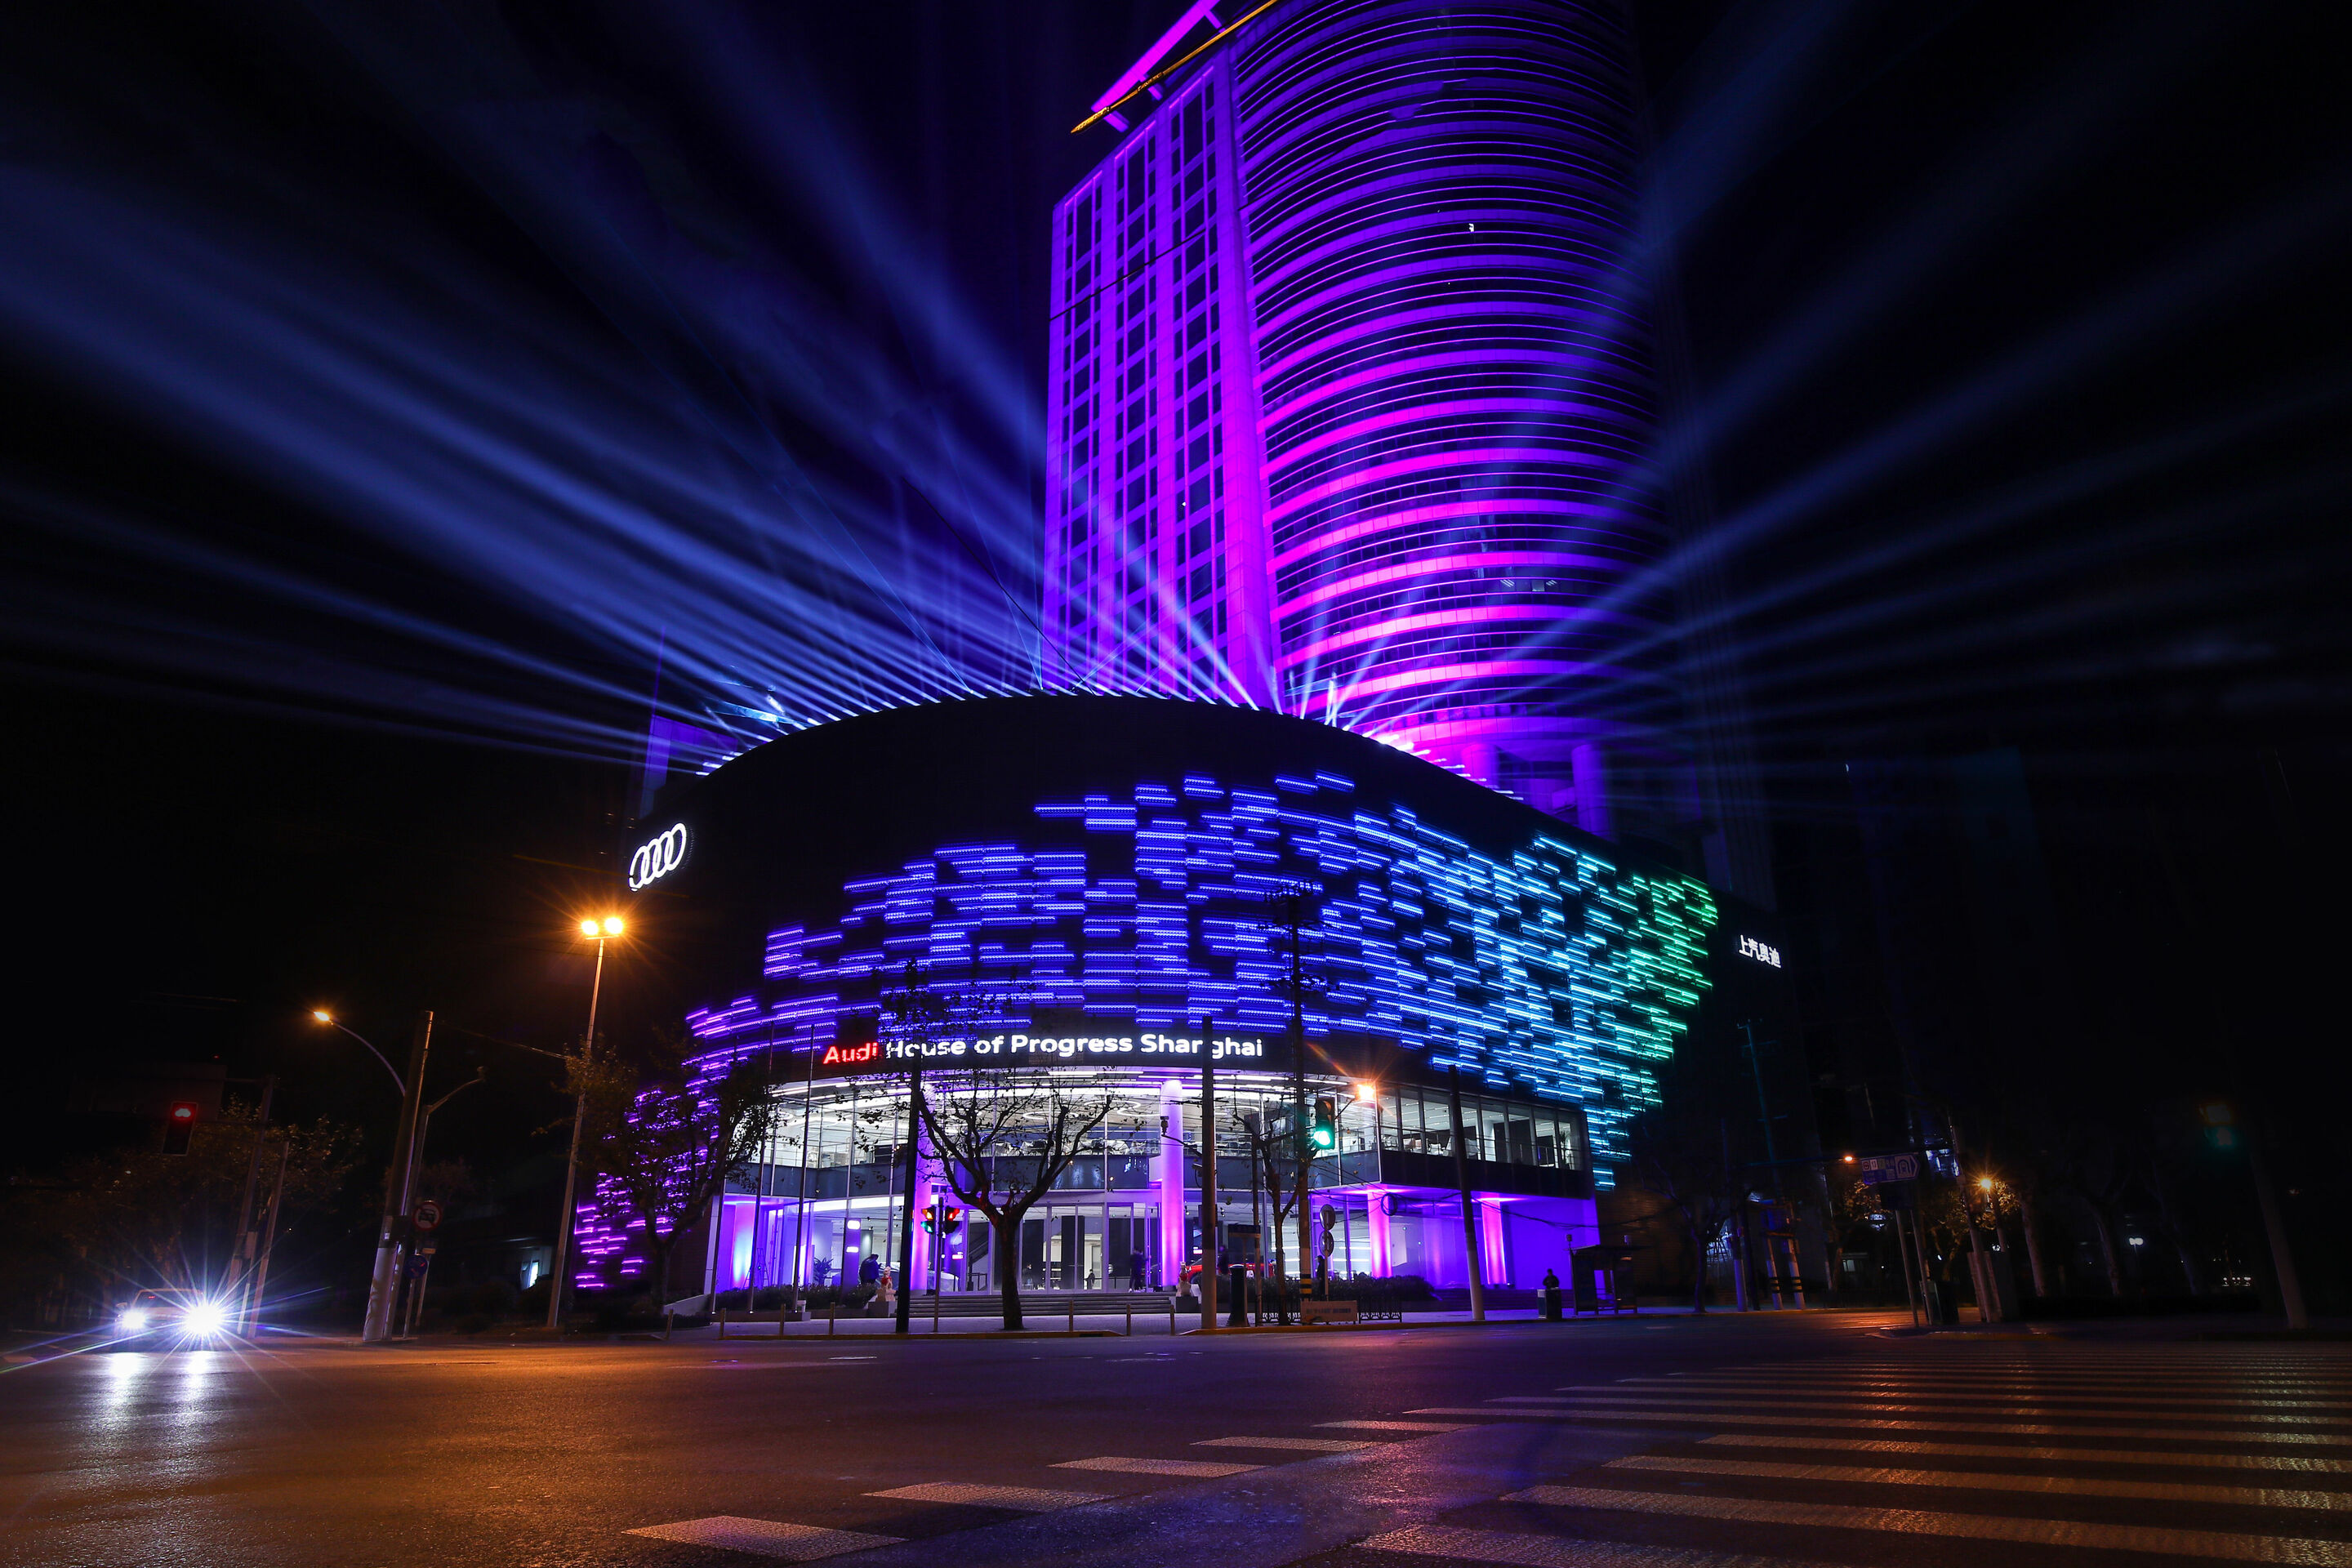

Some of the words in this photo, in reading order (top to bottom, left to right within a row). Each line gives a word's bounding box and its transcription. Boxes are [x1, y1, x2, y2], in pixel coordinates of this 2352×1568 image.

[1739, 934, 1782, 969] 上汽奥迪
[823, 1042, 878, 1064] Audi
[885, 1040, 966, 1059] House
[974, 1035, 1004, 1054] of
[1011, 1035, 1133, 1058] Progress
